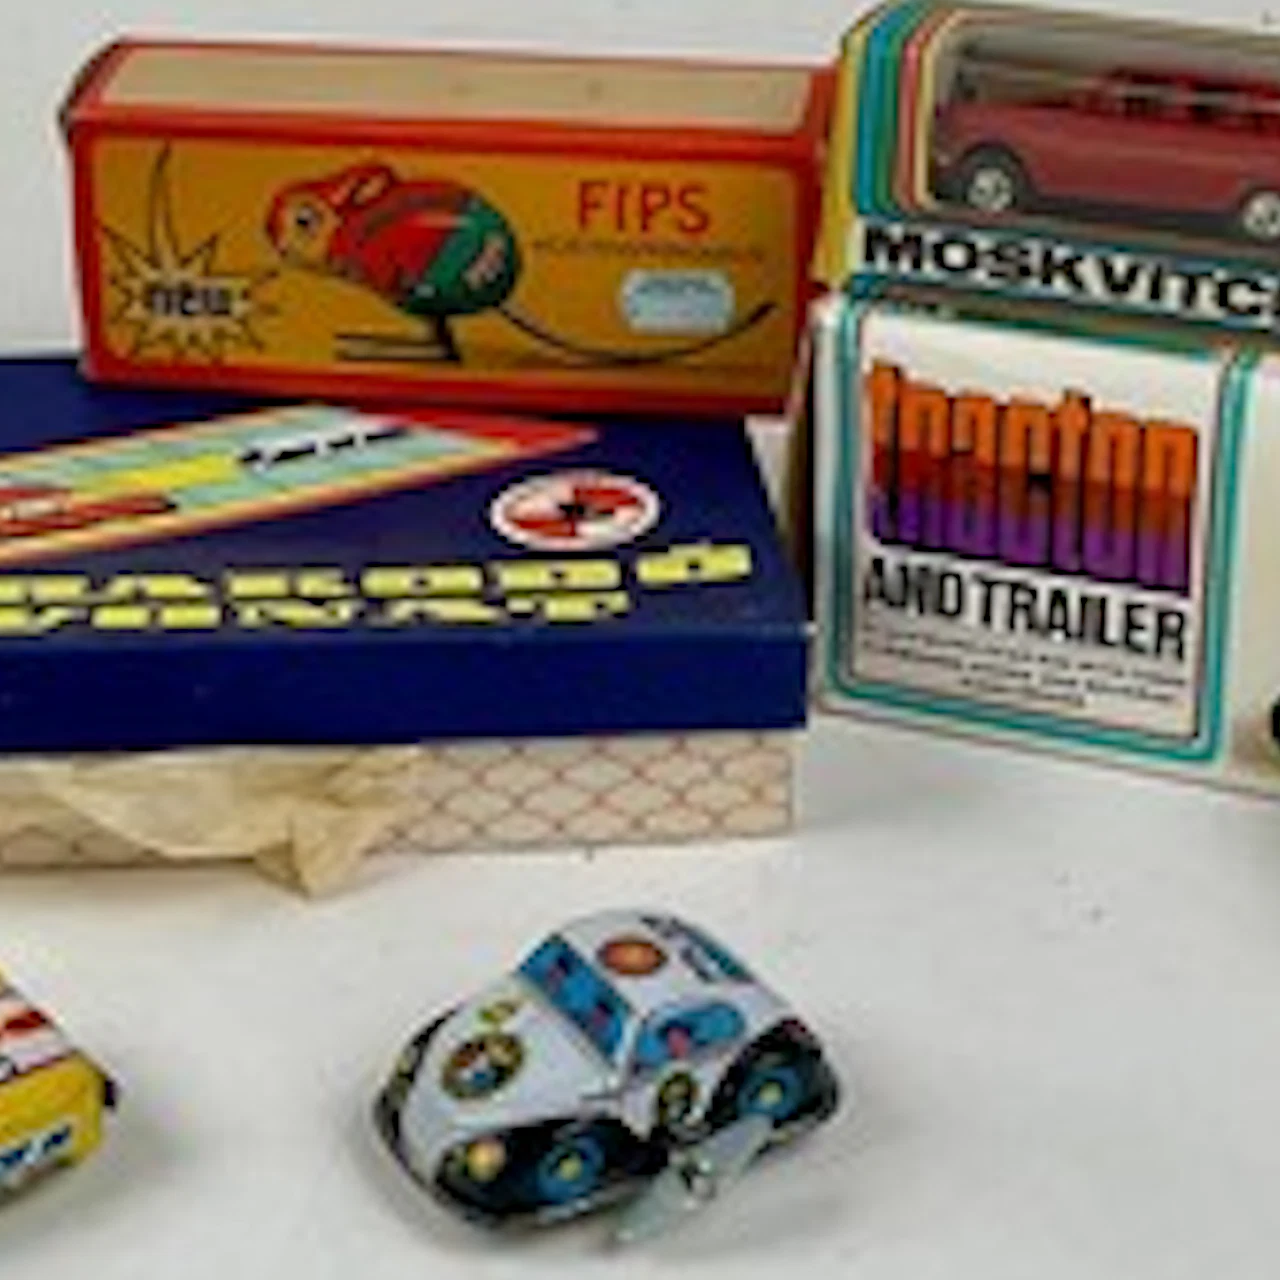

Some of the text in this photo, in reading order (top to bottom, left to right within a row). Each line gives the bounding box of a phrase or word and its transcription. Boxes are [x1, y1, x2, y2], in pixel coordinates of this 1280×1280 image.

[577, 179, 711, 236] FIPS
[861, 358, 1198, 596] tractor
[864, 557, 964, 617] AND
[975, 578, 1188, 664] TRAILER
